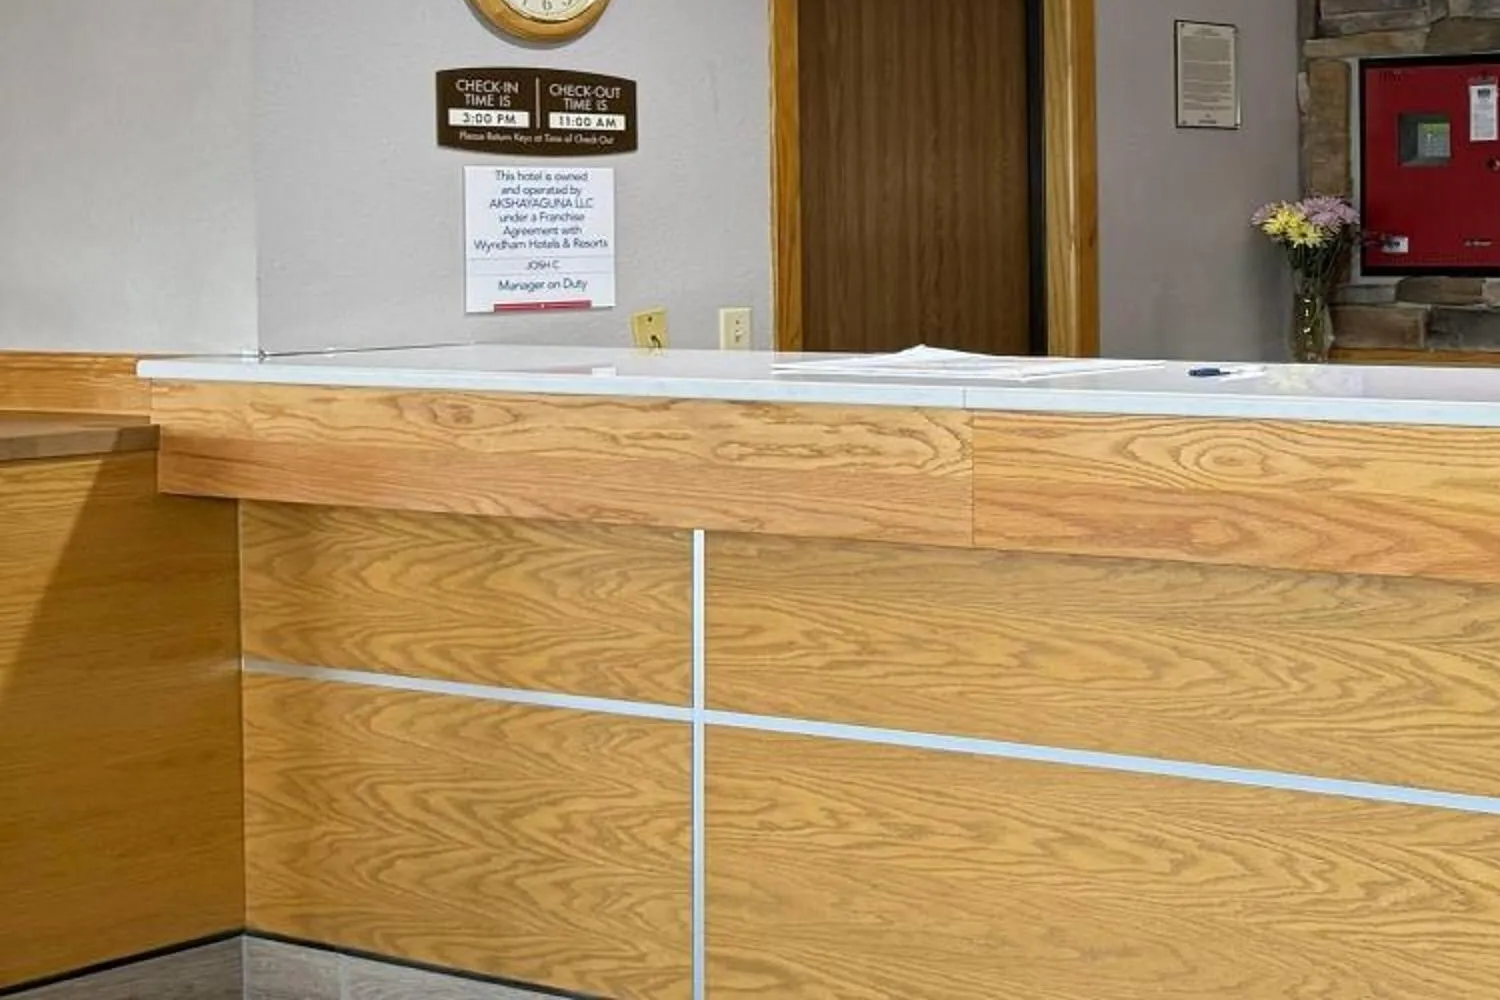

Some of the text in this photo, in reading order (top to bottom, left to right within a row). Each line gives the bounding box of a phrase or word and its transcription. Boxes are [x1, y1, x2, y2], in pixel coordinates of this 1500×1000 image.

[455, 79, 519, 94] CHECK-IN
[549, 83, 621, 99] CHECK-OUT
[464, 93, 512, 108] TIME IS
[563, 97, 609, 112] TIME IS
[462, 112, 517, 125] 3:00 PM
[559, 115, 617, 129] 11:00 AM
[513, 133, 532, 145] Keys
[495, 169, 515, 181] This
[517, 169, 542, 181] hotel
[554, 171, 588, 181] owned
[501, 185, 581, 197] and operated by
[575, 197, 593, 209] LLC
[500, 213, 528, 223] under
[539, 211, 585, 222] Franchise
[503, 226, 582, 238] Agreement with
[474, 237, 608, 253] Wyndham Hotels & Resorts
[498, 278, 588, 293] Manager on Duty
